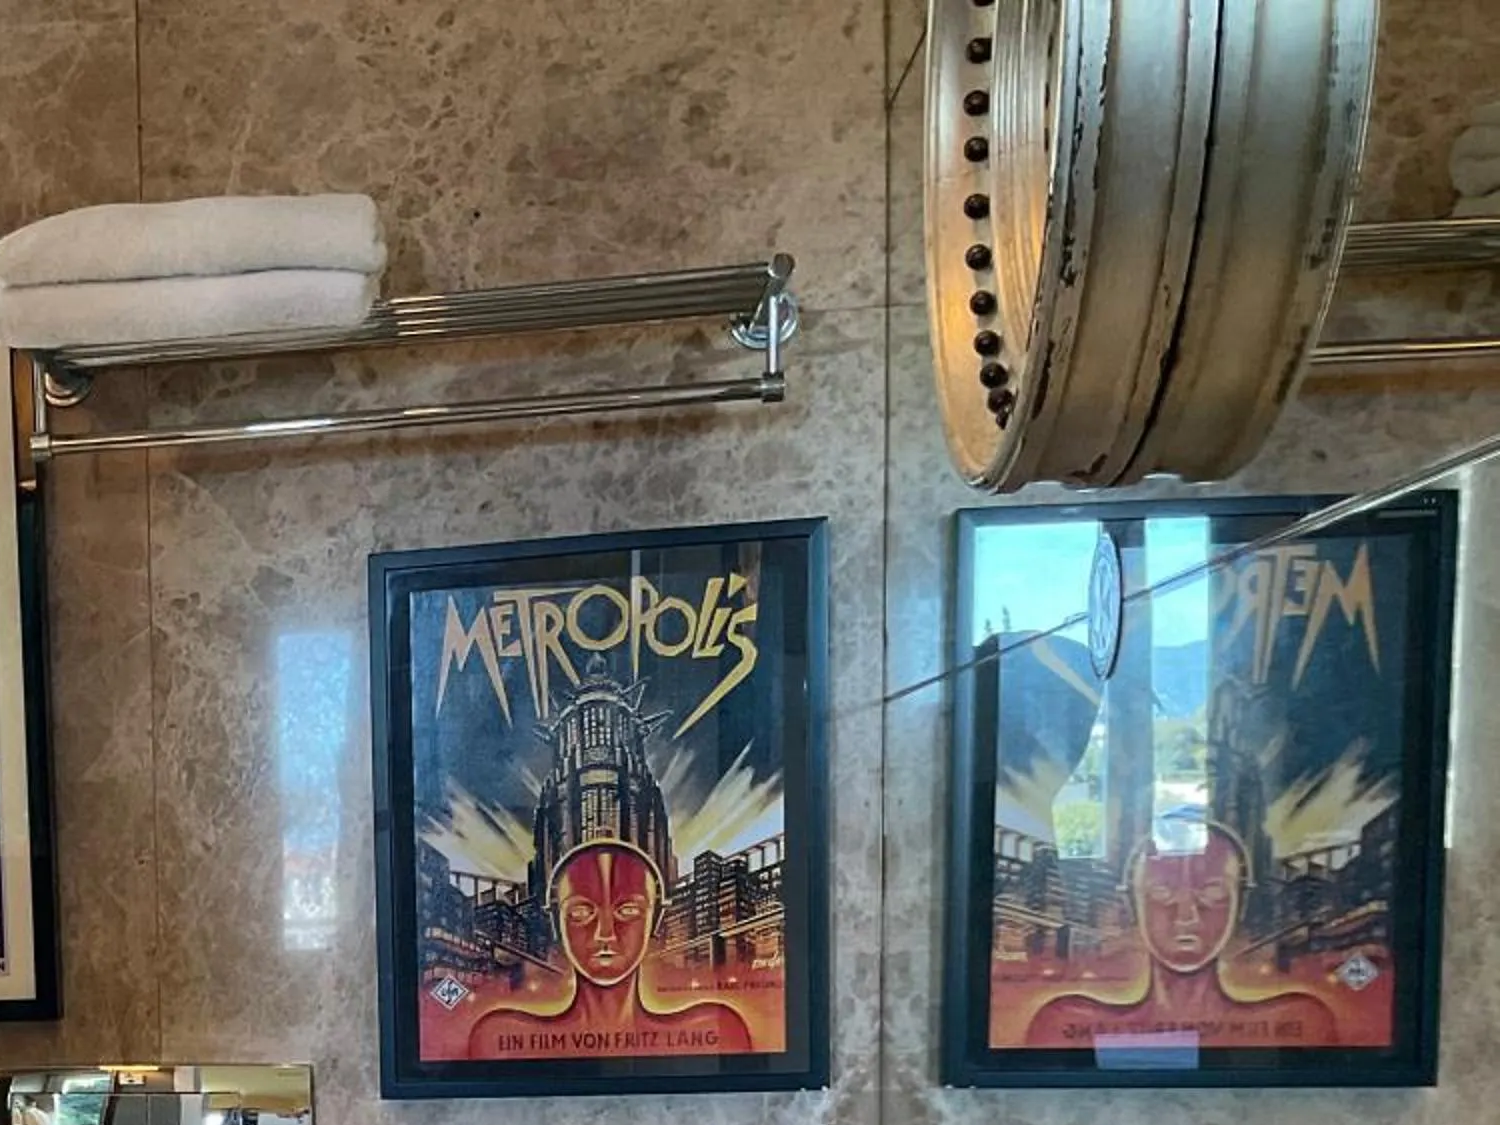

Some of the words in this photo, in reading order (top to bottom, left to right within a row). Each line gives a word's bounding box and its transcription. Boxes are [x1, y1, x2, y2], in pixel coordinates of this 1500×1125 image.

[435, 572, 758, 740] METROPOLIS
[499, 1034, 525, 1050] EIN
[529, 1033, 566, 1049] FILM
[572, 1032, 611, 1049] VON
[615, 1031, 658, 1048] FRITZ
[667, 1030, 719, 1048] LANG
